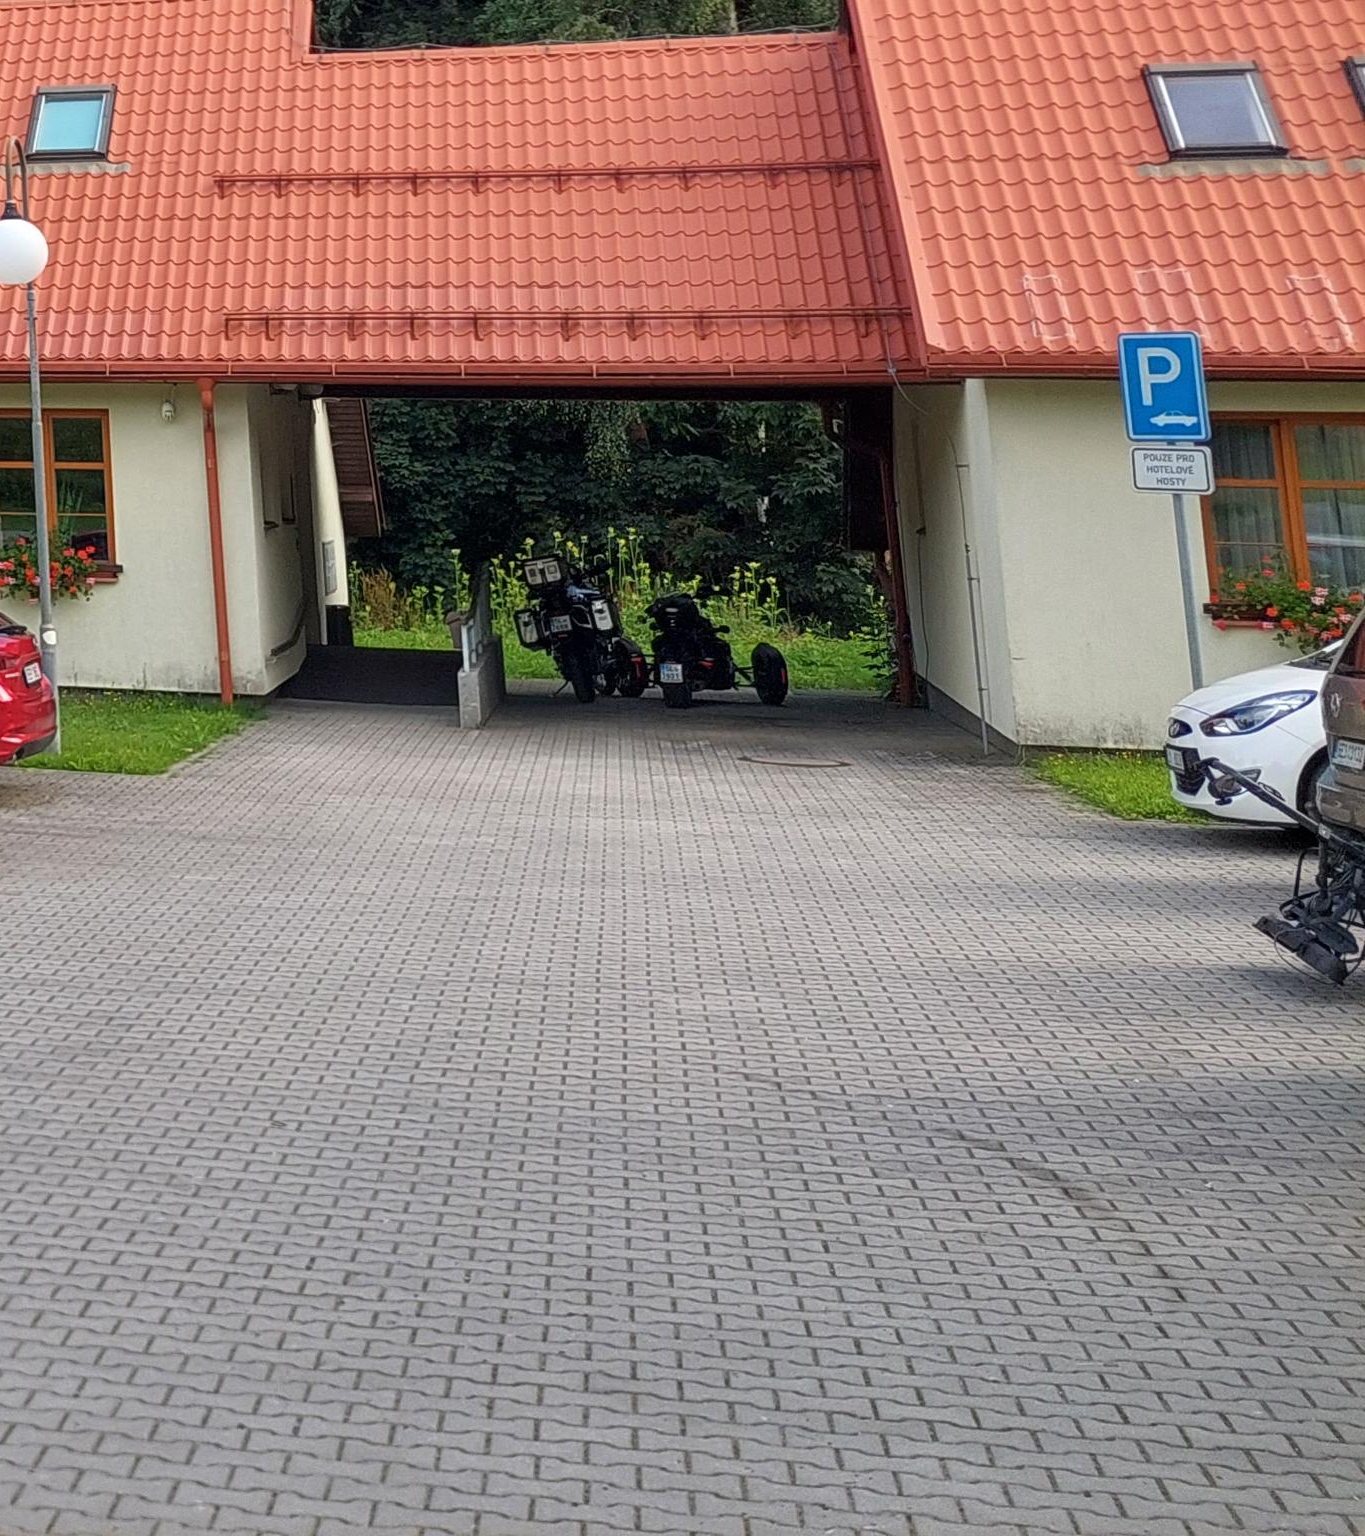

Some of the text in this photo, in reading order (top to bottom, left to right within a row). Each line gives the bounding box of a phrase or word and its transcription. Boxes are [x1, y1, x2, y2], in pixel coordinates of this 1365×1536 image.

[1137, 347, 1181, 407] P
[1143, 453, 1195, 463] POUZE PRO
[1146, 465, 1195, 475] HOTELOVÉ
[1156, 477, 1186, 486] HOSTY
